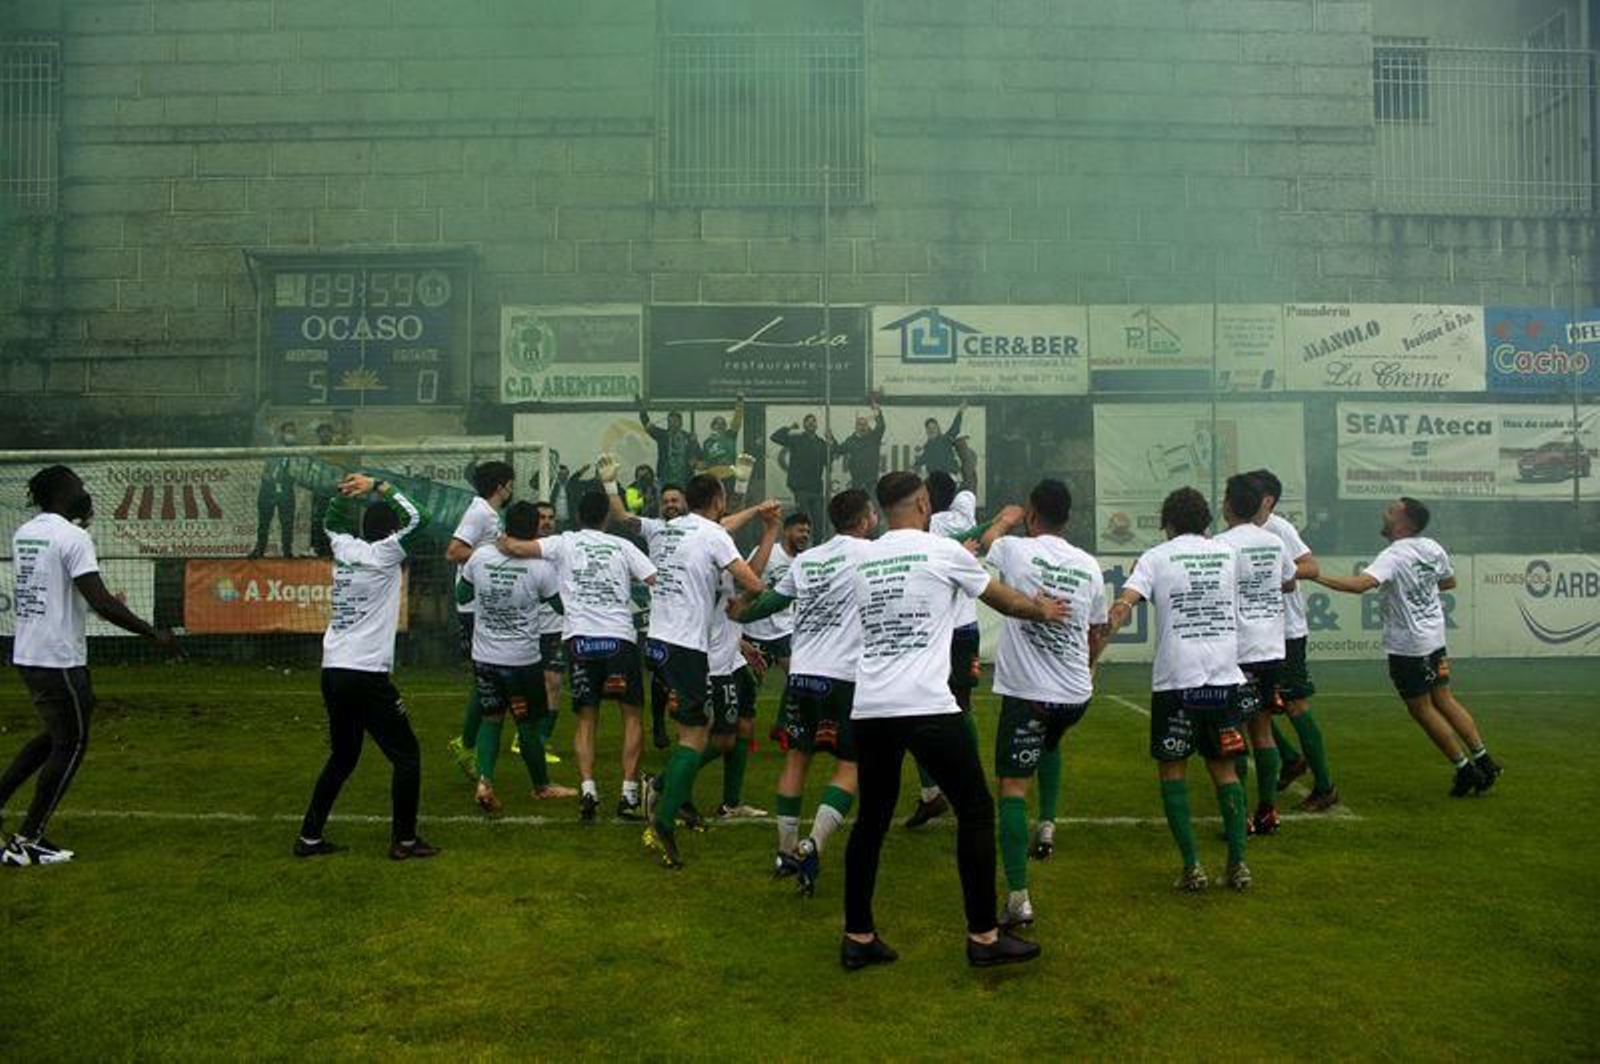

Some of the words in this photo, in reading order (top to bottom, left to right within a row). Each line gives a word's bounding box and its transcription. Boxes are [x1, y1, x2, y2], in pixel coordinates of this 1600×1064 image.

[301, 314, 424, 340] OCASO
[964, 336, 1079, 355] CER&BER
[1493, 343, 1590, 374] Cacho
[1323, 361, 1363, 386] La
[308, 369, 327, 403] 5
[417, 369, 438, 403] 0
[505, 376, 538, 398] C.D.
[541, 375, 640, 397] ARENTEIRO
[1345, 413, 1410, 434] SEAT
[1416, 413, 1493, 436] Ateca
[244, 579, 262, 602] A
[1309, 639, 1386, 652] pocerber.c
[722, 684, 739, 705] 15
